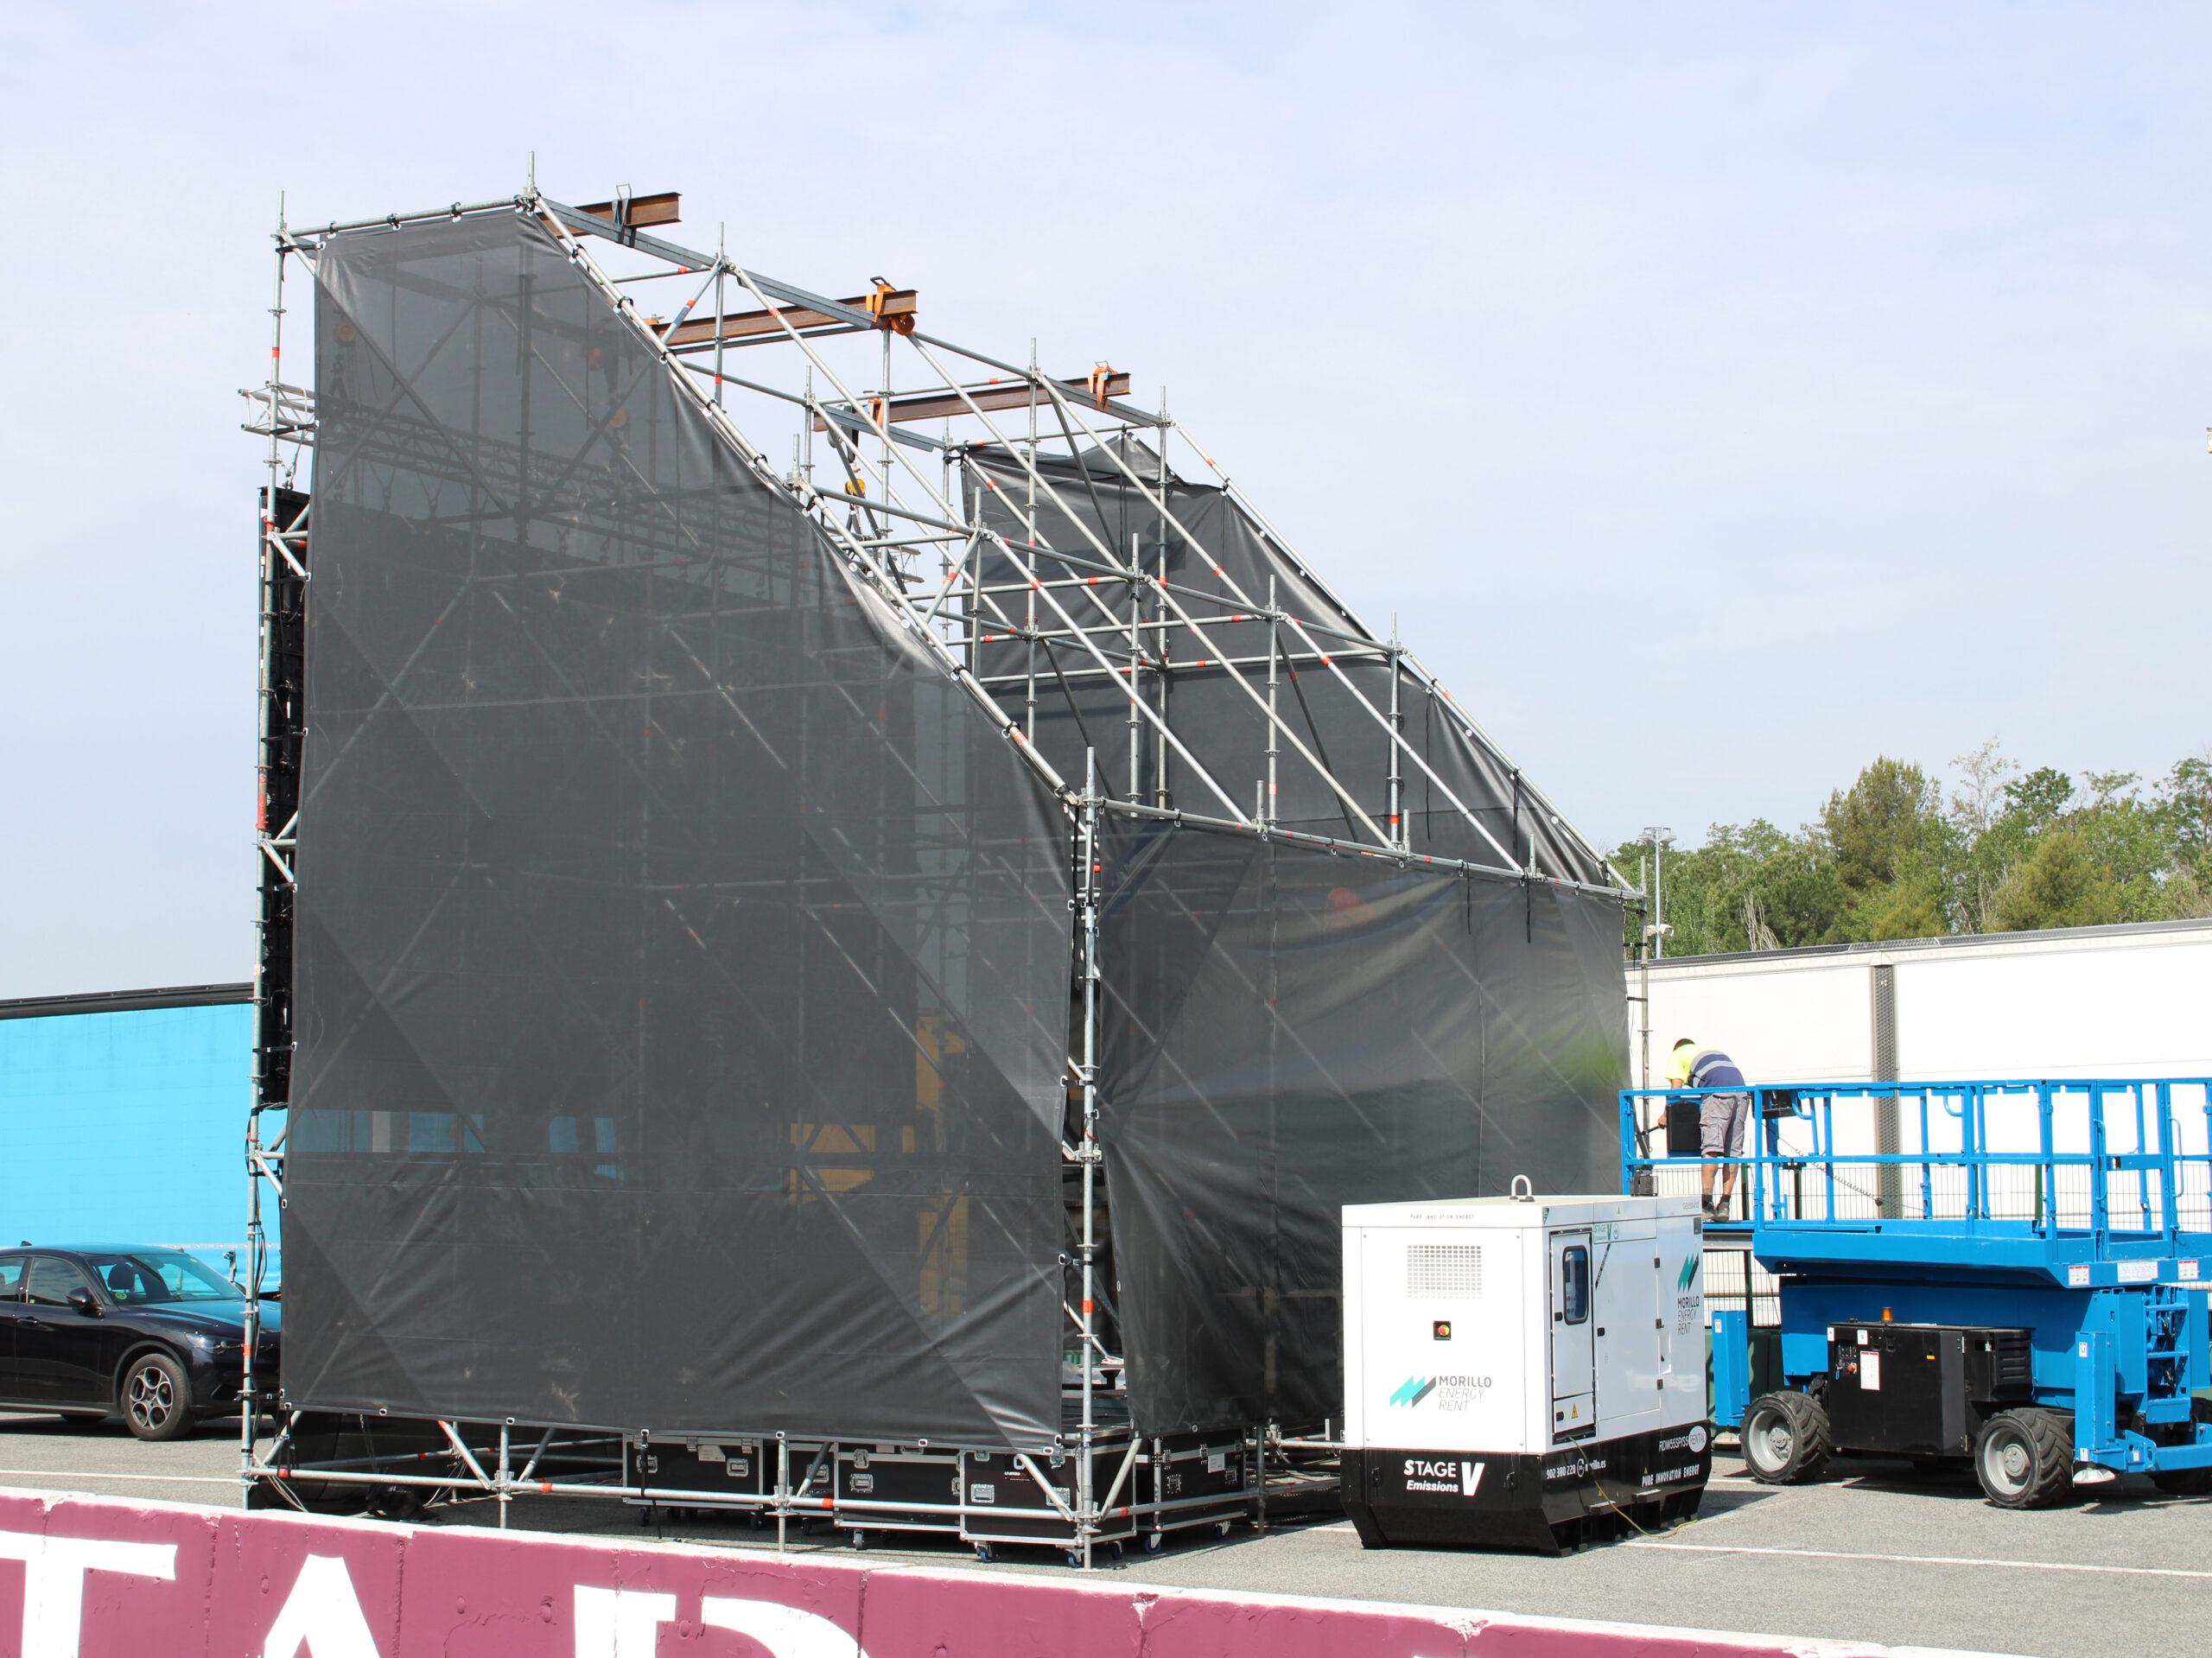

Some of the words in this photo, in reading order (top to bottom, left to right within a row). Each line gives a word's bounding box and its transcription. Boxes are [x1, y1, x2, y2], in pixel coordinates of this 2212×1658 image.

[1677, 1296, 1700, 1309] MORILLO
[1678, 1309, 1697, 1322] ENERGY
[1677, 1322, 1691, 1335] RENT
[1439, 1375, 1492, 1388] MORILLO
[1439, 1388, 1484, 1400] ENERGY
[1439, 1400, 1470, 1411] RENT
[1690, 1433, 1706, 1445] RENTAL
[1403, 1459, 1457, 1477] STAGE
[1461, 1462, 1485, 1496] V
[1546, 1468, 1556, 1480] 902
[1556, 1466, 1567, 1477] 380
[1567, 1464, 1576, 1475] 220
[1642, 1474, 1654, 1487] PURE
[1656, 1468, 1681, 1484] INNOVATION
[1683, 1464, 1700, 1478] ENERGY
[1406, 1480, 1459, 1493] Emissions
